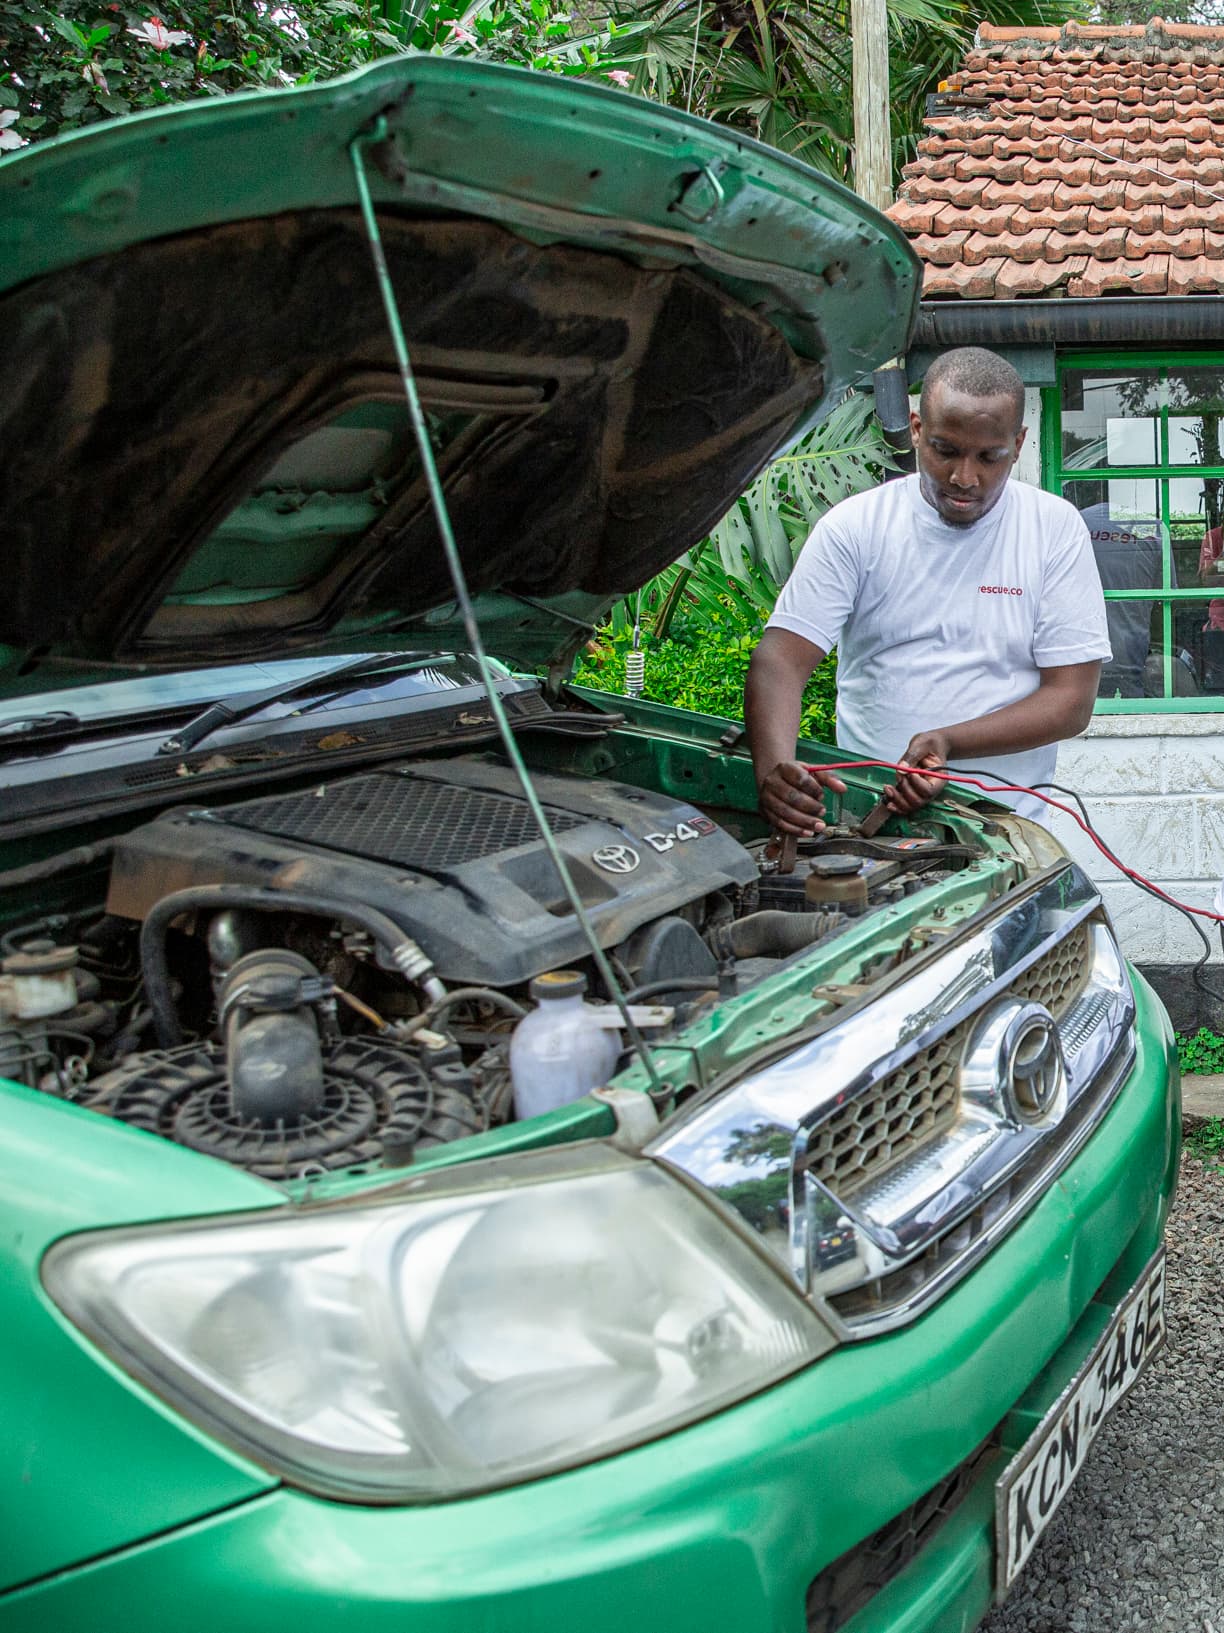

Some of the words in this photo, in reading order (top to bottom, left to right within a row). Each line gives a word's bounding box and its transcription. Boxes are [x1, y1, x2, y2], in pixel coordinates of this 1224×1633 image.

[643, 817, 717, 852] D-4D
[1014, 1399, 1080, 1558] KCN
[1089, 1271, 1162, 1428] 346E
